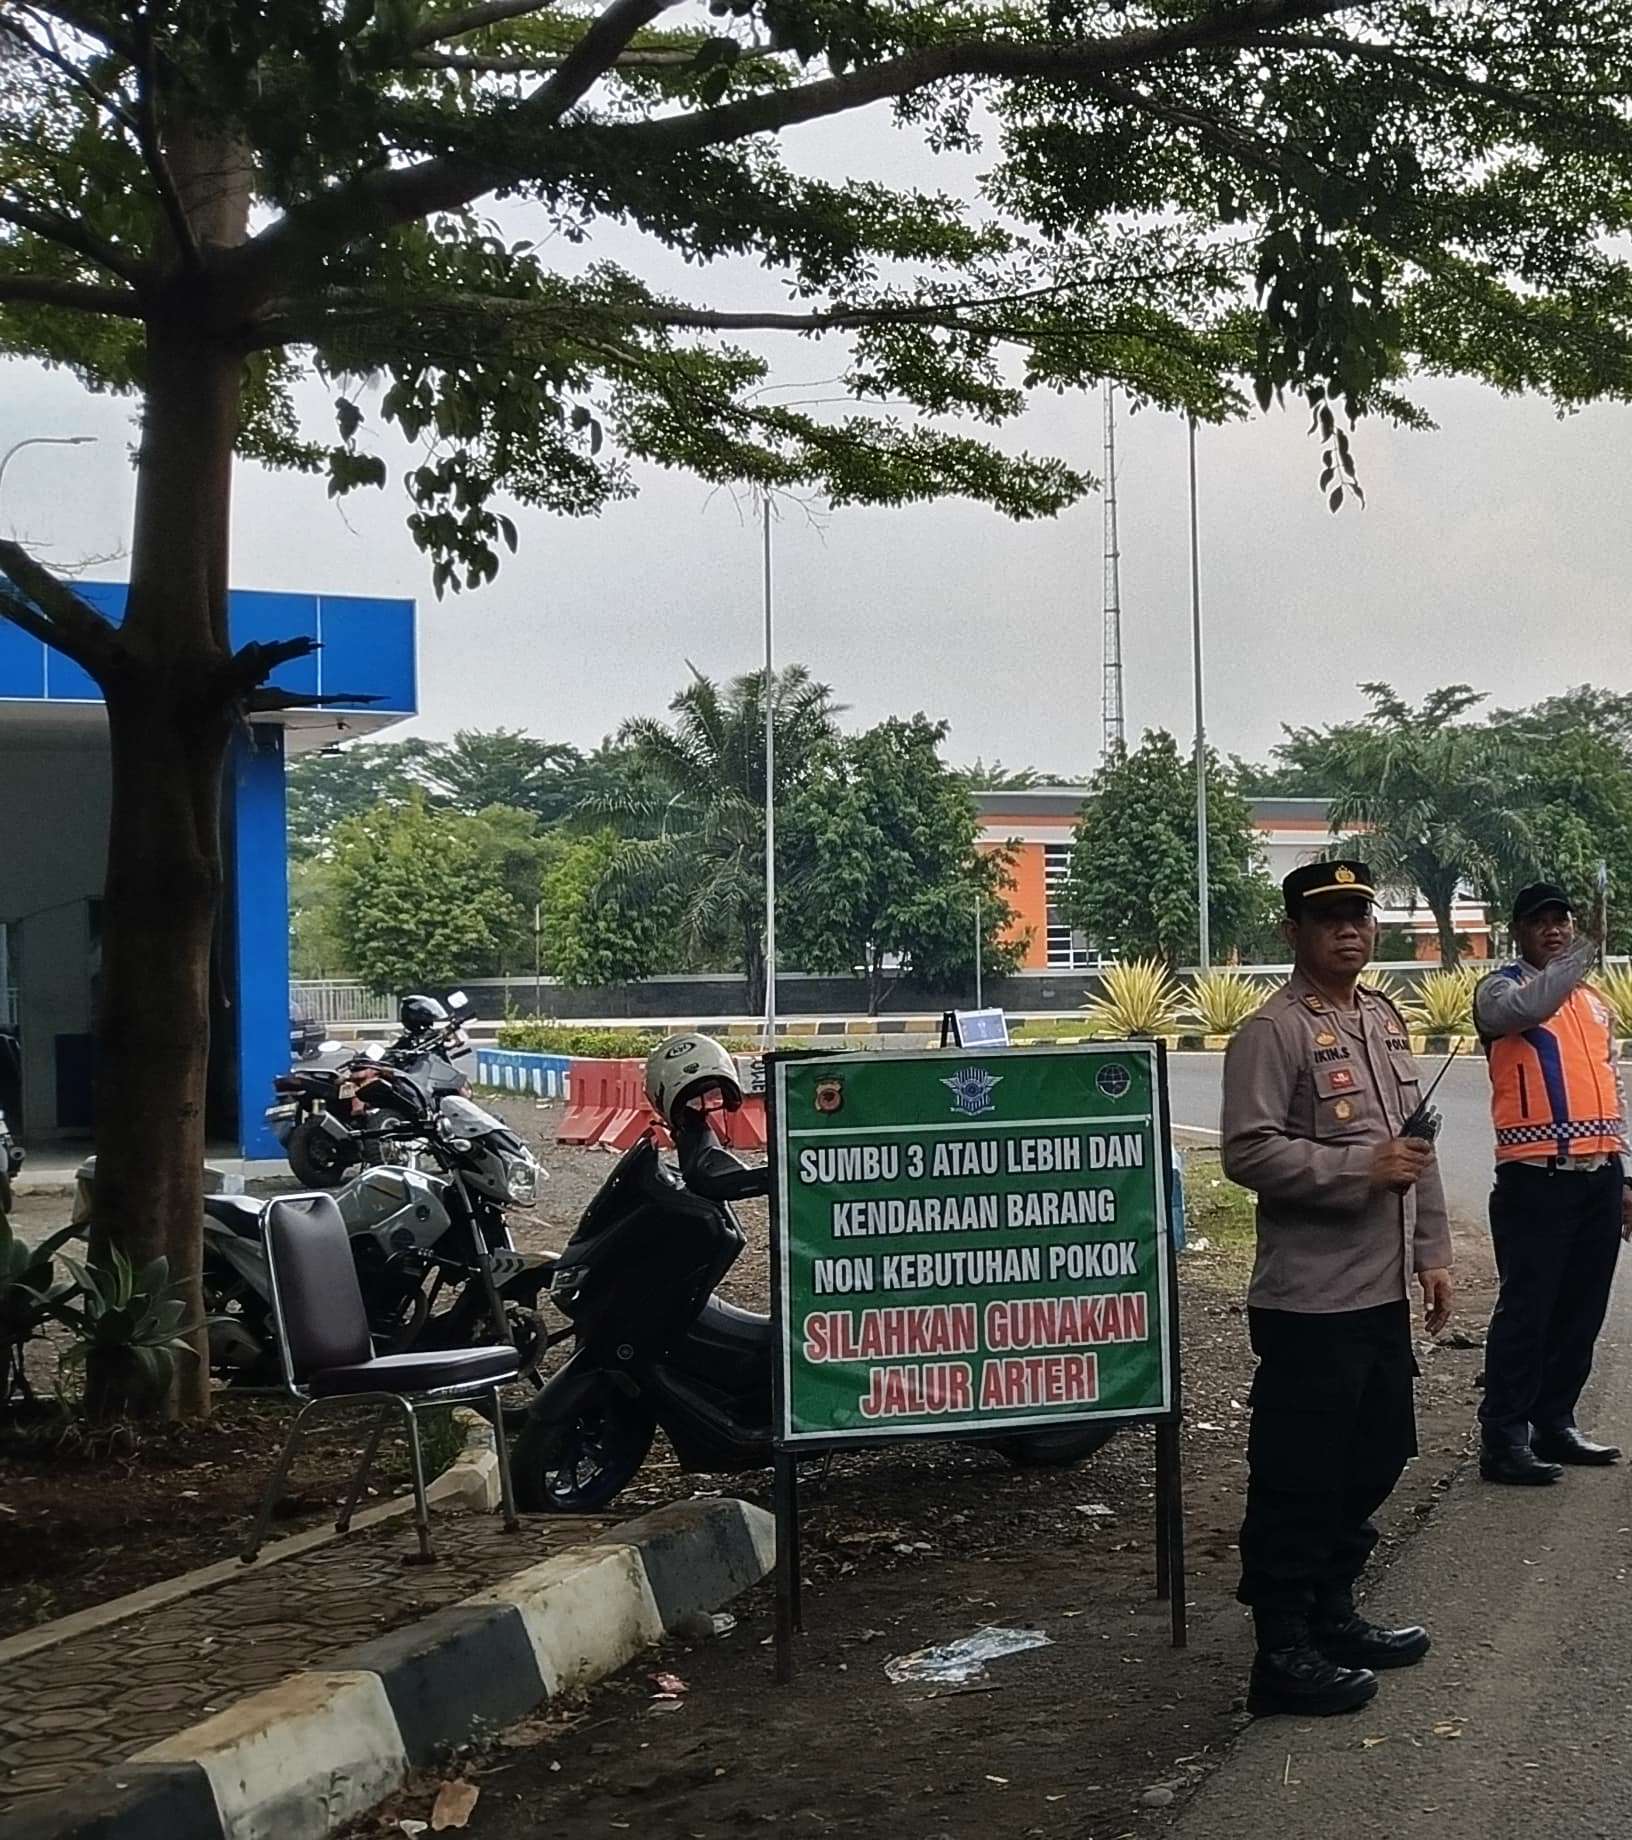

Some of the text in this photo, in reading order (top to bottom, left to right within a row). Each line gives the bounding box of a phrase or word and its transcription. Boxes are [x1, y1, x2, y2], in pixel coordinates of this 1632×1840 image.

[800, 1134, 1143, 1184] SUMBU 3 ATAU LEBIH DAN
[833, 1189, 1115, 1237] KENDARAAN BARANG
[814, 1241, 1137, 1294] NON KEBUTUHAN POKOK
[804, 1292, 1148, 1364] SILAHKAN GUNAKAN
[860, 1352, 1098, 1419] JALUR ARTERI
